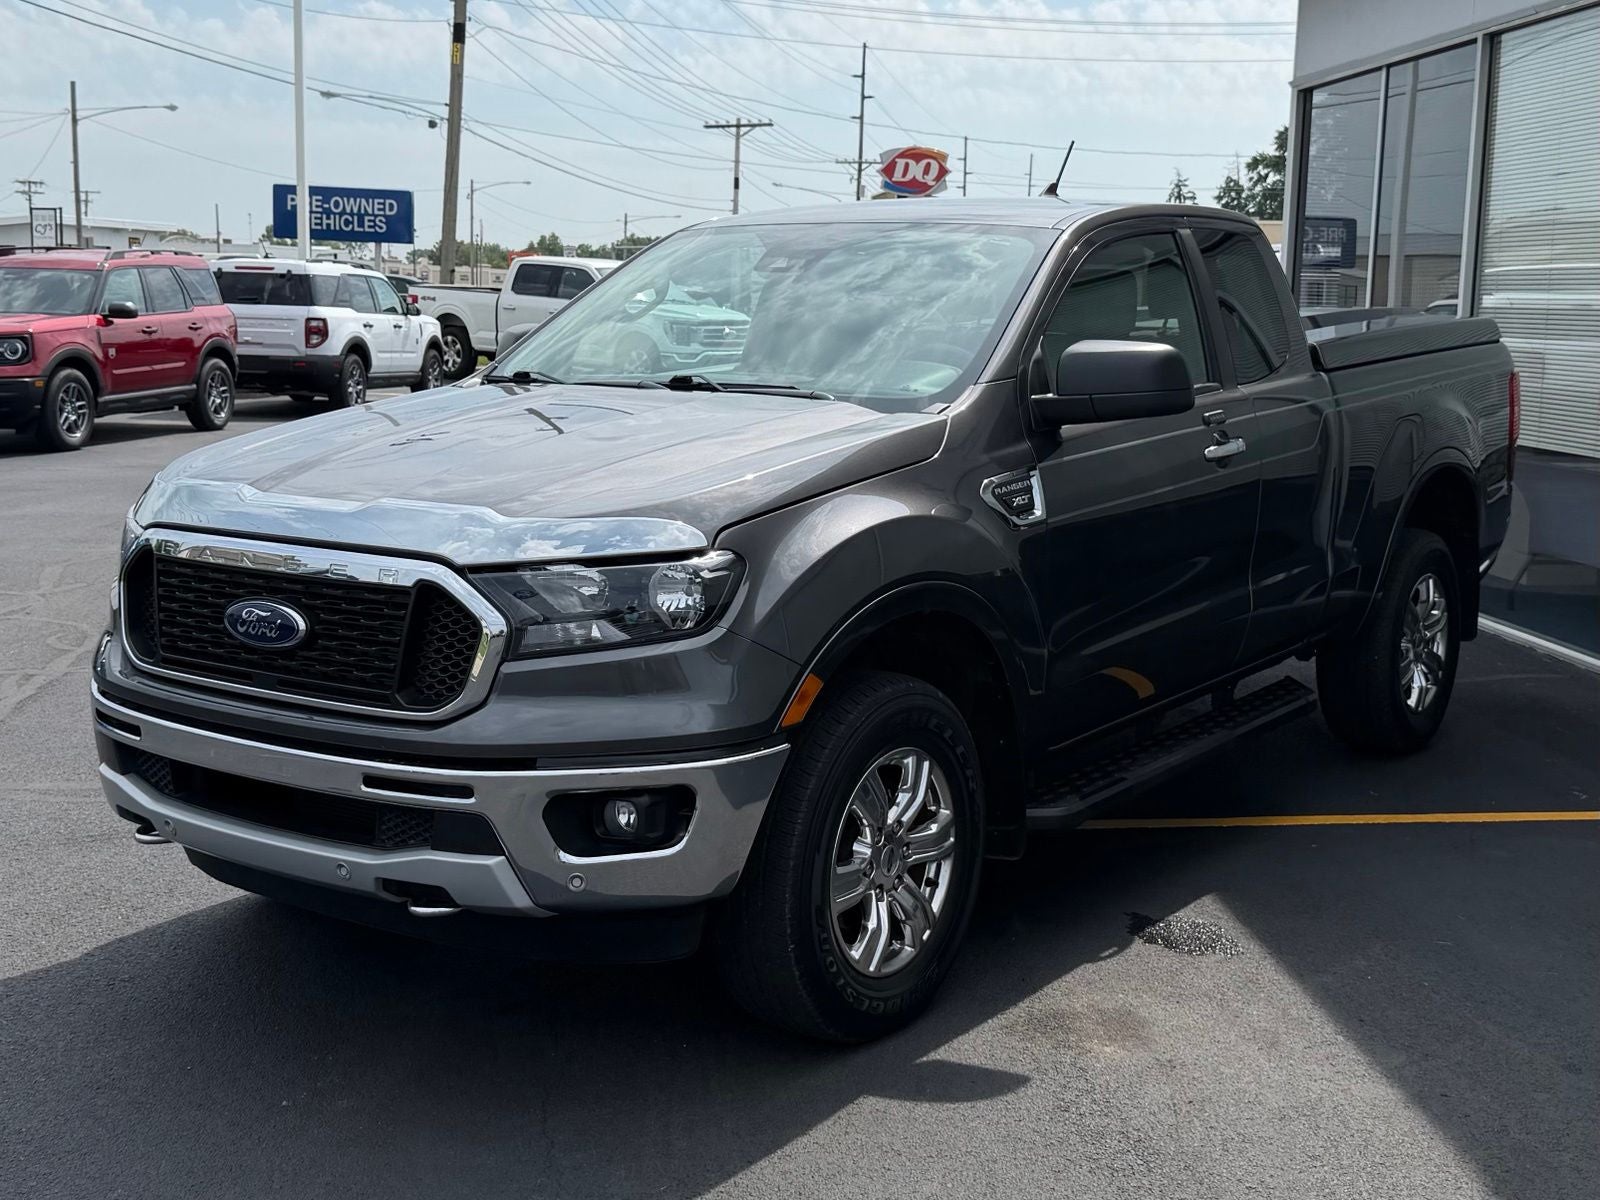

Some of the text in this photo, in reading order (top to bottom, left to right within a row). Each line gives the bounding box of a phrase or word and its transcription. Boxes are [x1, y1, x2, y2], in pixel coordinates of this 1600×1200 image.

[892, 158, 939, 186] DQ
[287, 194, 398, 216] PE-OWNED
[310, 213, 387, 233] EHICLES
[994, 480, 1031, 495] RANGER
[1012, 495, 1031, 506] XLT
[162, 540, 400, 584] RANGER
[237, 607, 282, 638] Ford
